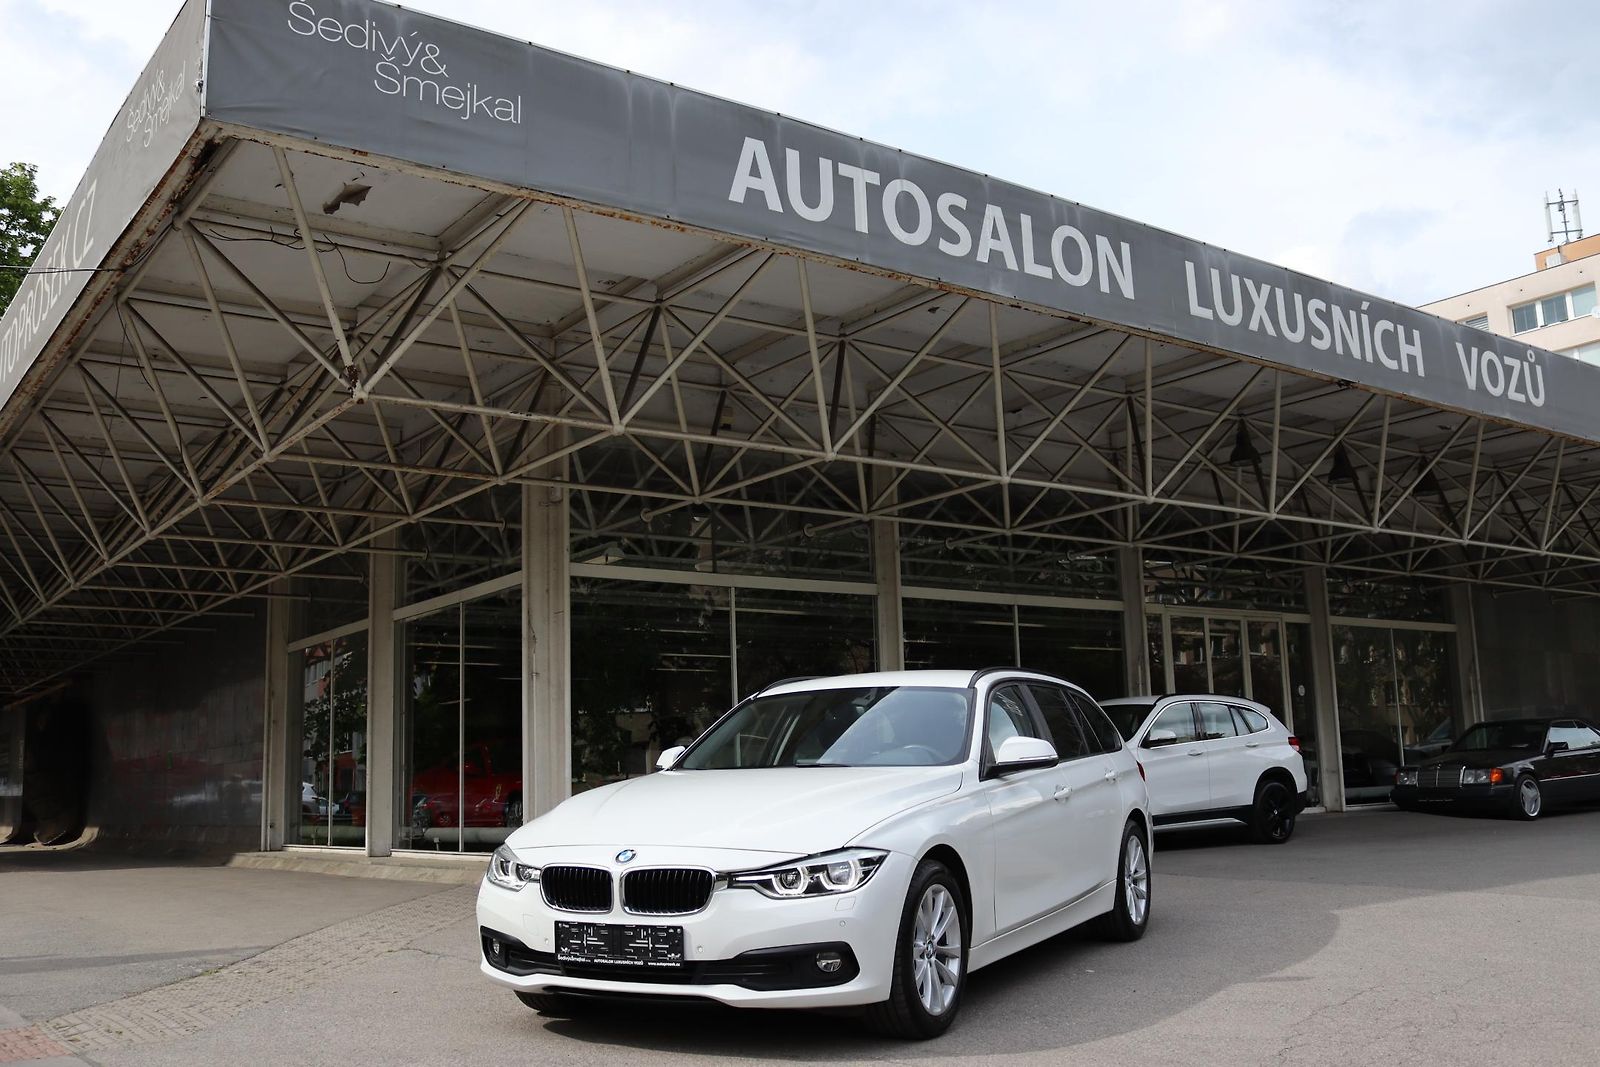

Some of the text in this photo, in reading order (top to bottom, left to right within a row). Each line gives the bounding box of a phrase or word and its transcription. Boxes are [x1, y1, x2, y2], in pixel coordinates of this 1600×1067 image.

[374, 53, 521, 124] Šmejkal
[728, 136, 1545, 407] AUTOSALON LUXUSNÍCH VOZŮ
